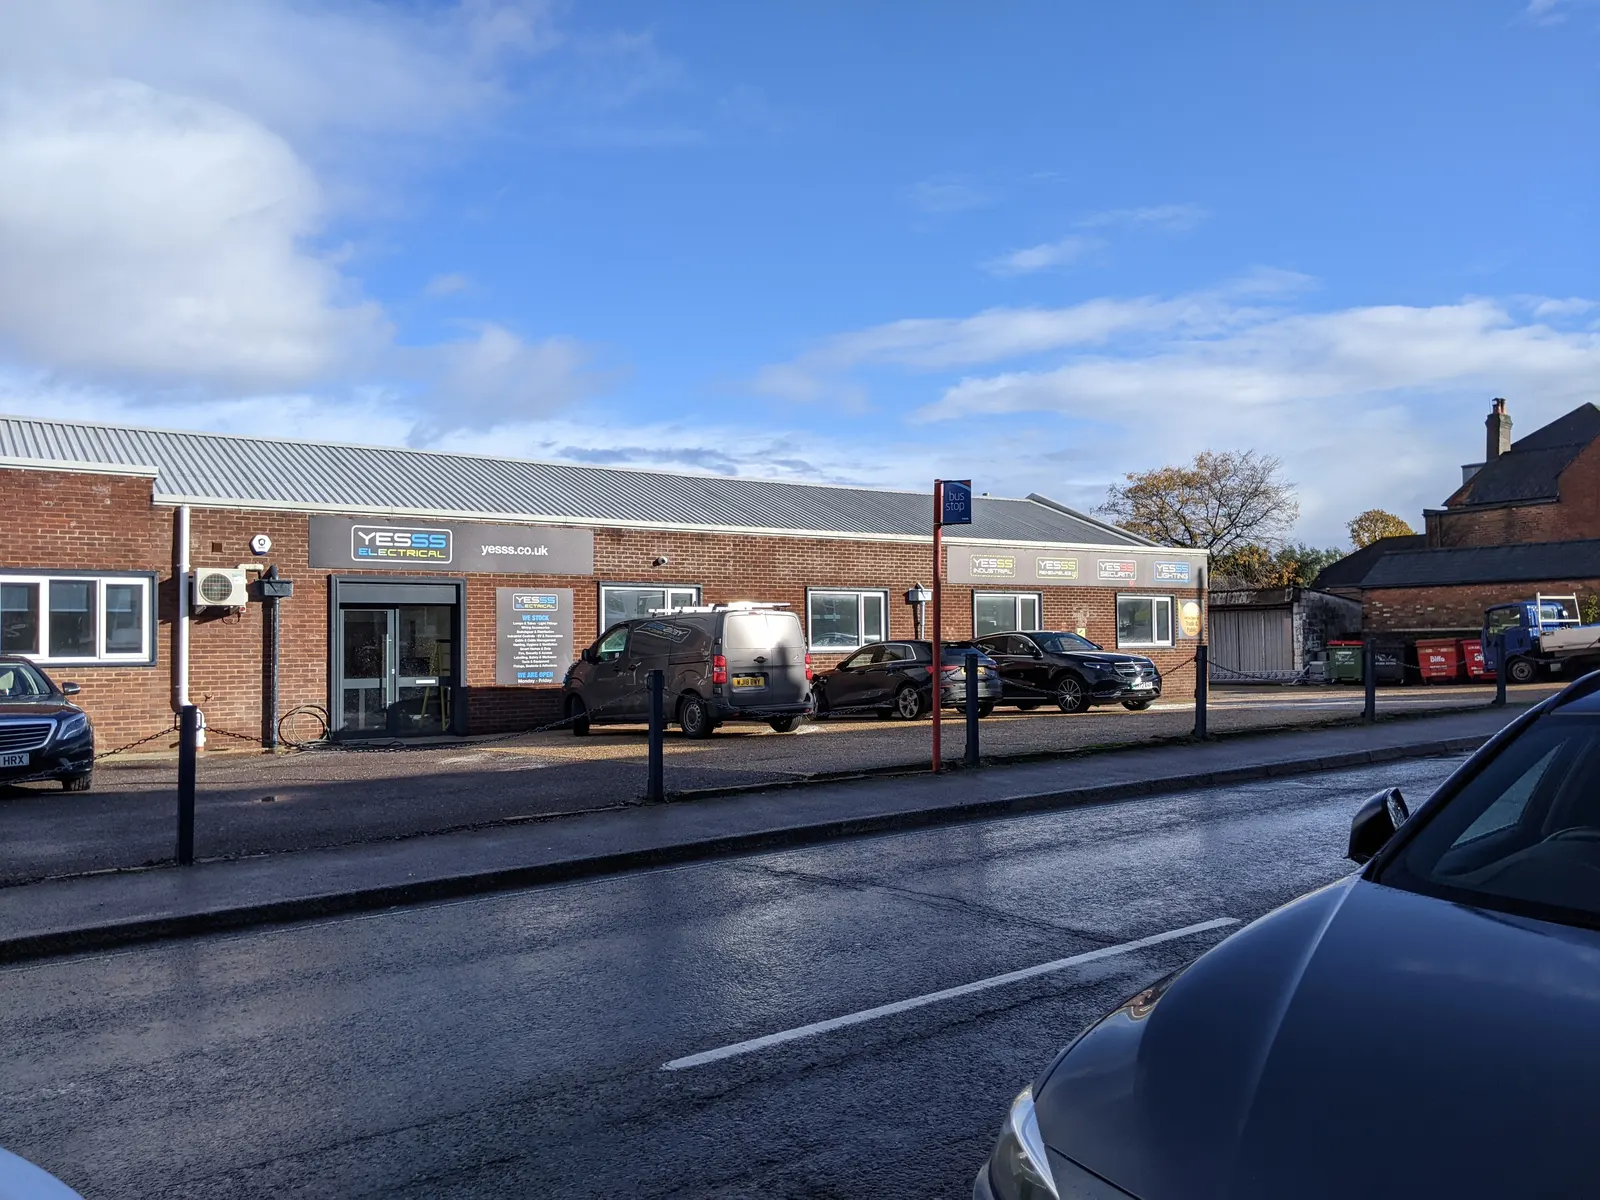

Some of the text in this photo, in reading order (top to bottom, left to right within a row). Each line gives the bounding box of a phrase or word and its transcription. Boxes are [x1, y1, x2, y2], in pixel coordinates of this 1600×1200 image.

[948, 491, 964, 501] bus
[946, 502, 964, 512] stop
[357, 531, 446, 548] YESSS
[358, 548, 446, 558] ELECTRICAL
[481, 544, 548, 556] yesss.co.uk
[973, 558, 1012, 568] YESSS
[1038, 560, 1075, 570] YESSS
[1099, 562, 1134, 572] YESSS
[1156, 564, 1188, 572] YESSS
[3, 756, 24, 765] HRX
